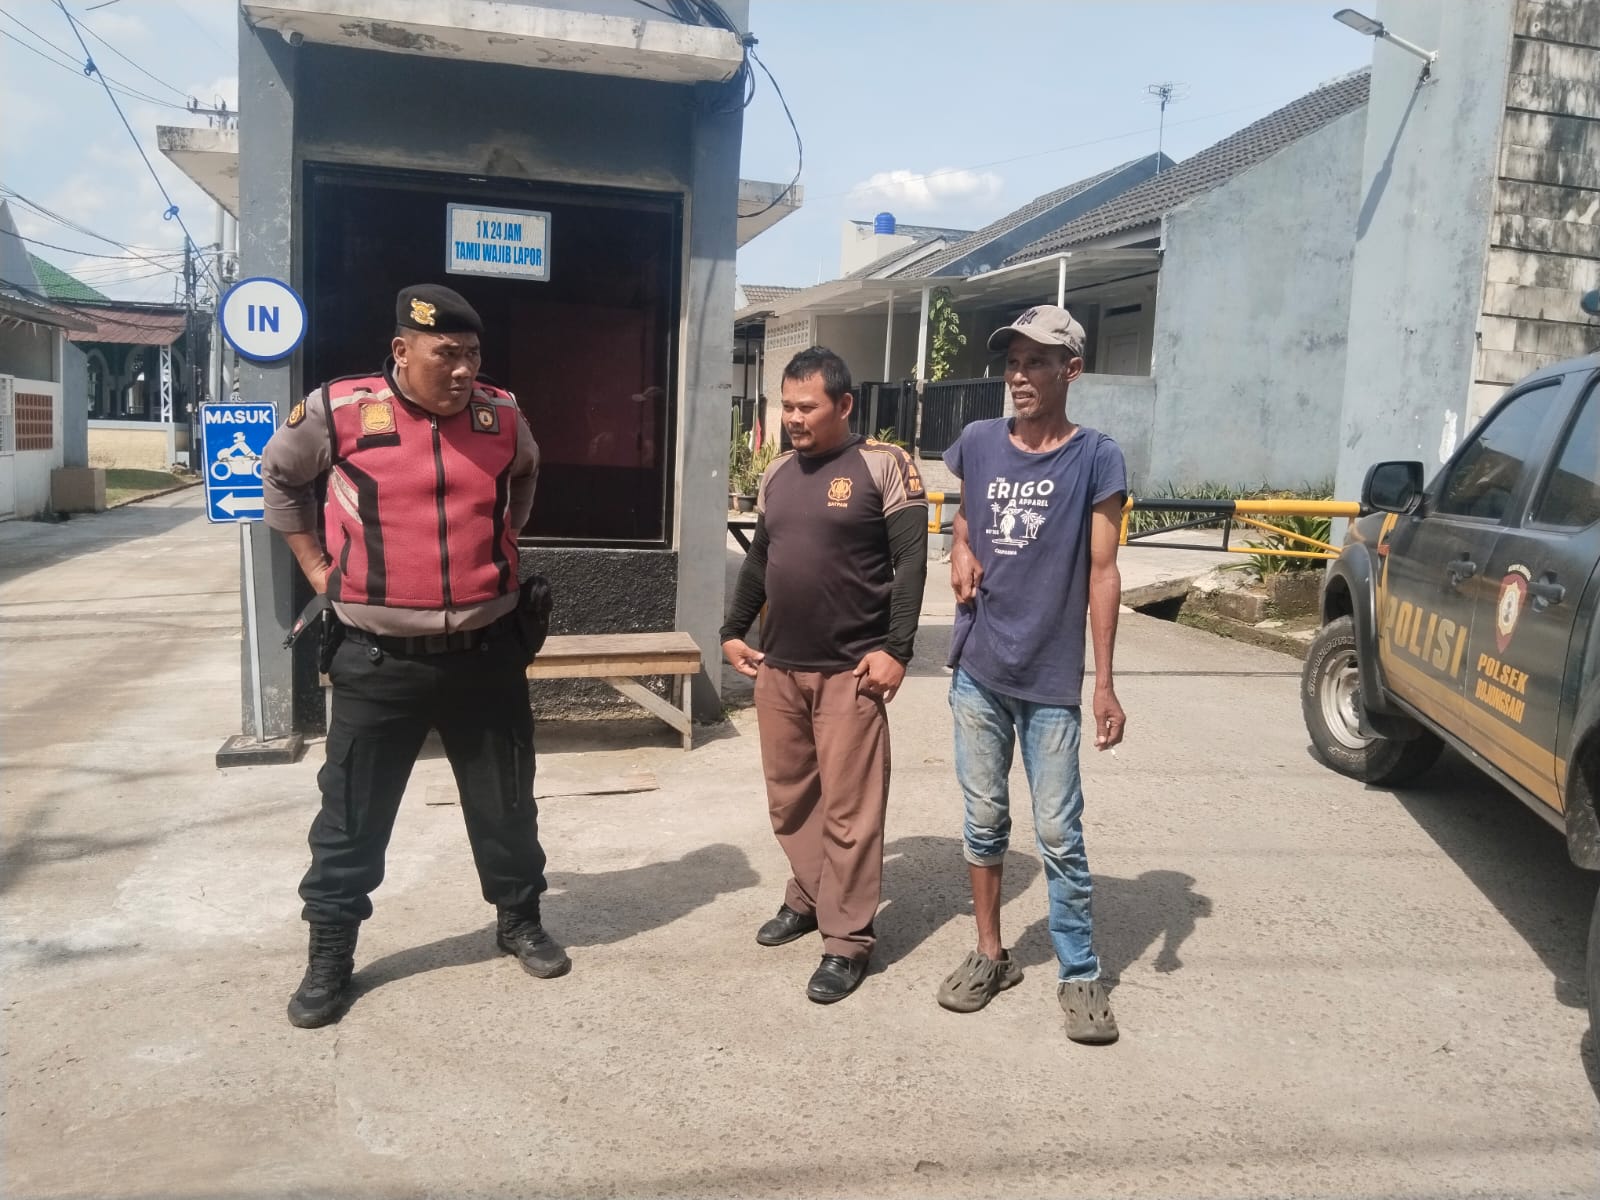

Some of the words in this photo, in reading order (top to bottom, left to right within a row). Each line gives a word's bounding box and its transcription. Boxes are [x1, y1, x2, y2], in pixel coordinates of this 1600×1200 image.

[476, 220, 481, 238] 1
[483, 221, 489, 239] X
[490, 221, 502, 240] 24
[504, 222, 522, 242] JAM
[455, 241, 480, 260] TAMU
[482, 243, 511, 263] WAJIB
[513, 246, 542, 266] LAPOR
[248, 304, 279, 333] IN
[205, 409, 272, 424] MASUK
[987, 479, 1055, 499] ERIGO
[1018, 498, 1049, 507] APPAREL
[1384, 596, 1468, 679] POLISI
[1476, 652, 1529, 695] POLSEK
